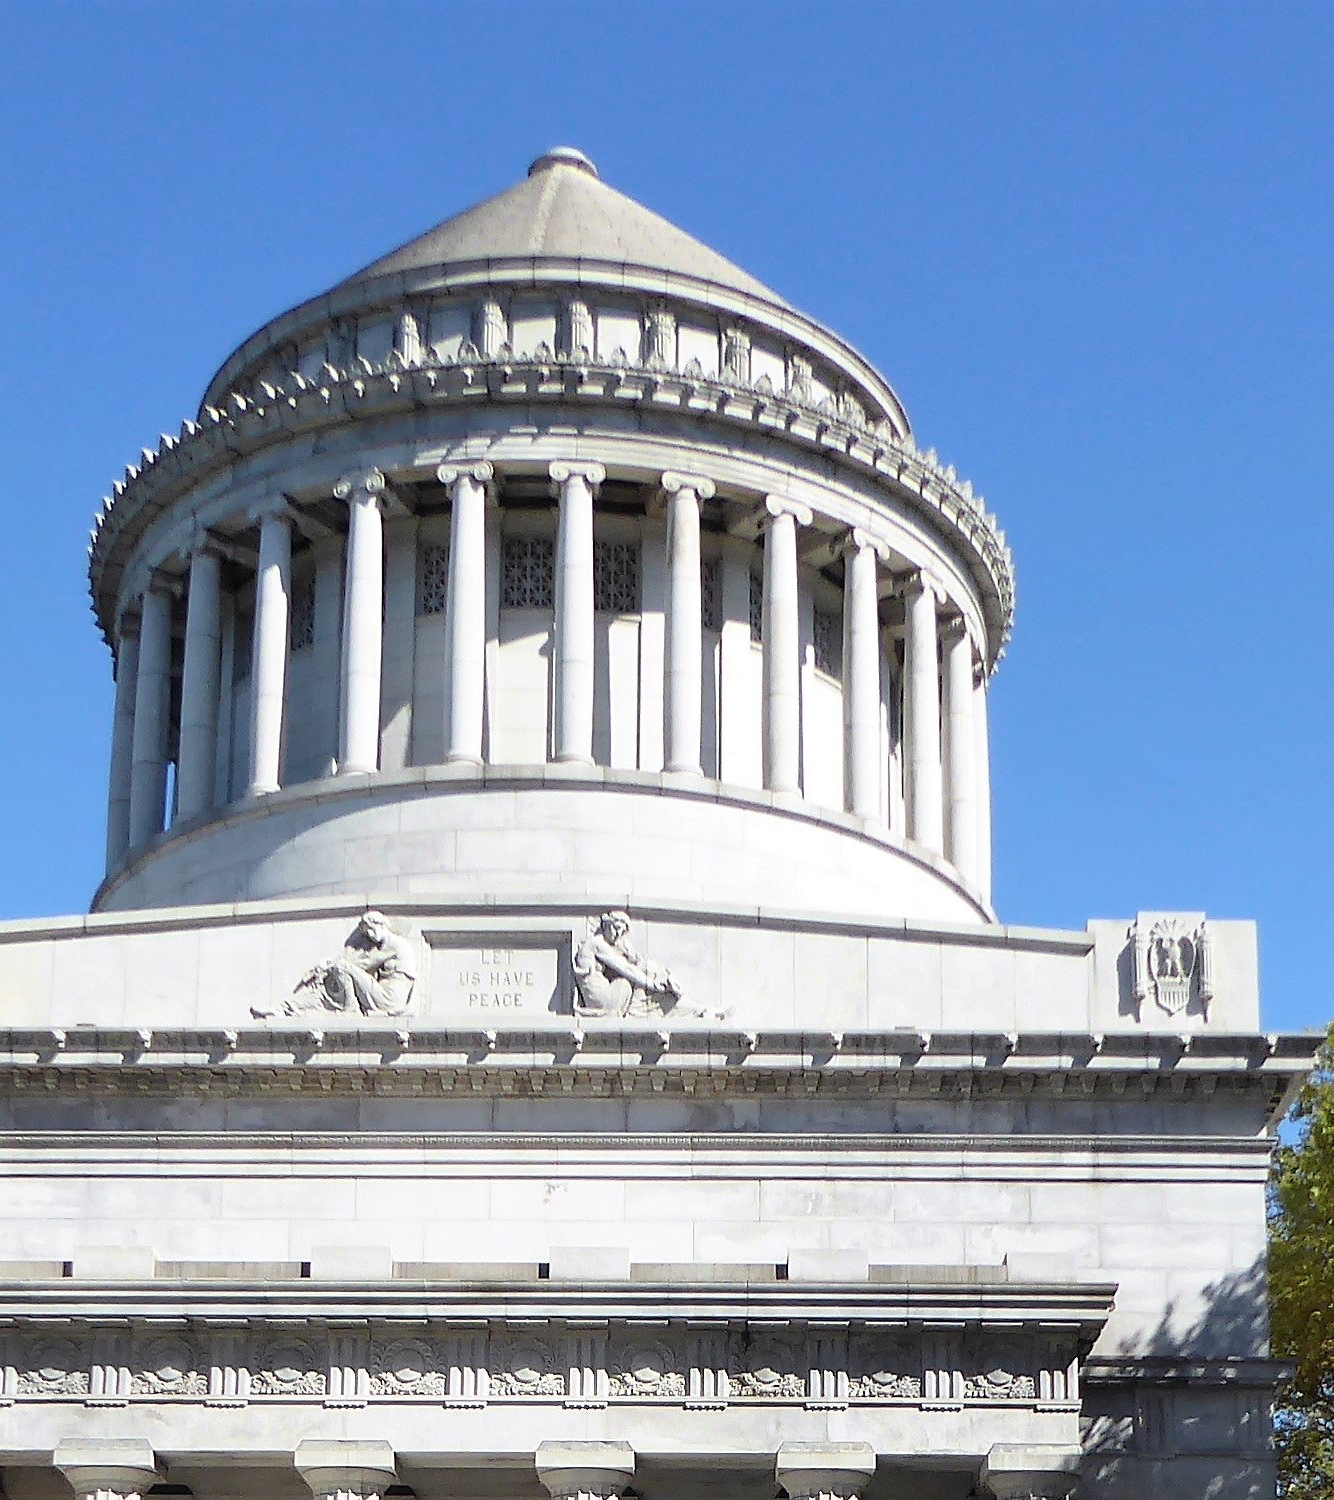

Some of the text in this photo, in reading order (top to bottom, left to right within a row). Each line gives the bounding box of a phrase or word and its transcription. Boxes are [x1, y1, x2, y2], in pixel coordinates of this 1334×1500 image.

[480, 949, 514, 965] LET
[459, 971, 534, 987] US HAVE
[468, 993, 523, 1008] PEACE
